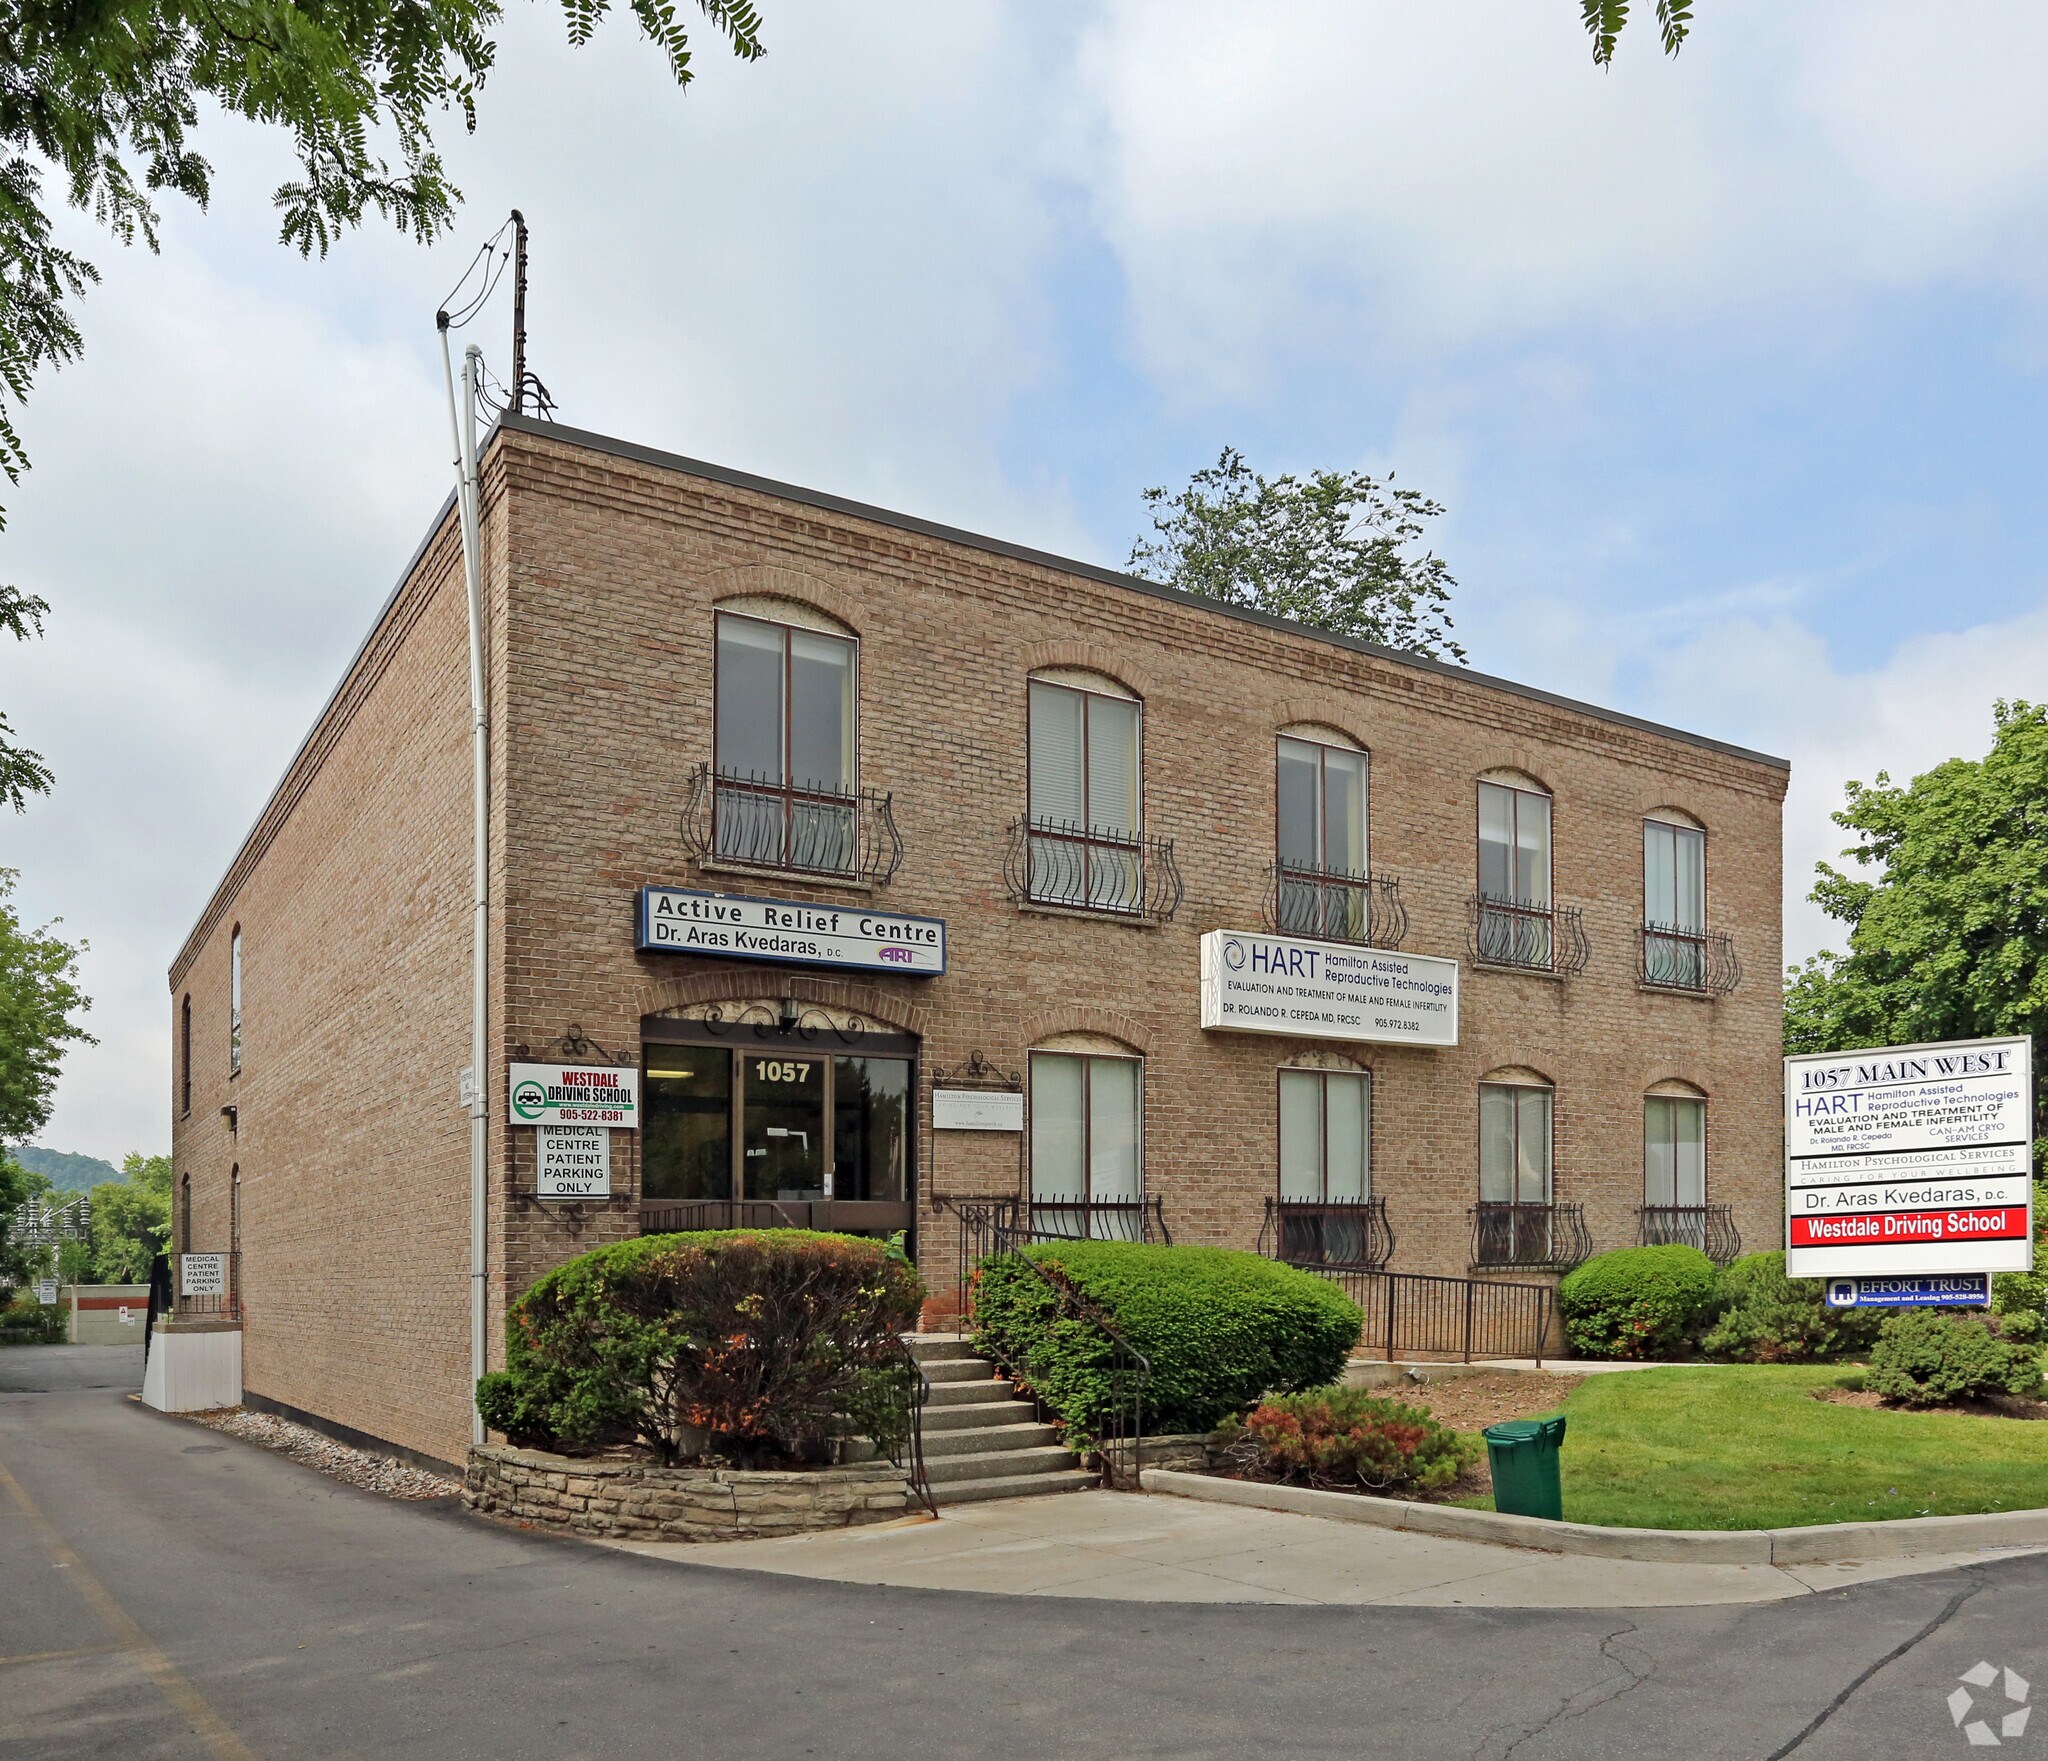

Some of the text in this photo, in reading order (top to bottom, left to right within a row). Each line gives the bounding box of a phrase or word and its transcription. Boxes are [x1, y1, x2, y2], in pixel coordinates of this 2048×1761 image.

[657, 896, 937, 942] Active Relief Centre
[656, 923, 844, 958] Dr. Aras Kvedaras, D.C.
[1252, 943, 1320, 978] HART
[1325, 953, 1408, 975] Hamilton Assisted
[1325, 969, 1452, 996] Reproductive Technologies
[1228, 980, 1447, 1013] EVALUATION AND TREATMENT OF MALE AND FEMALE INFERTILITY
[1223, 1002, 1420, 1031] DR. ROLANDO R. CEPEDA MD, FRCSC 905.972.8382
[562, 1071, 619, 1088] WESTDALE
[756, 1060, 810, 1083] 1057
[1802, 1050, 2011, 1090] 1057 MAIN WEST
[548, 1086, 632, 1103] DRIVING SCHOOL
[1868, 1084, 1963, 1101] Hamilton Assisted
[1868, 1090, 2019, 1113] Reproductive Technologies
[560, 1108, 624, 1122] 905-522-8381
[1796, 1094, 1864, 1118] HART
[1809, 1103, 2004, 1127] EVALUATION AND TREATMENT OF
[544, 1126, 603, 1137] MEDICAL
[1814, 1112, 1999, 1135] MALE AND FEMALE INFERTILITY
[1929, 1122, 2006, 1137] CAN-AM CRYO
[546, 1140, 600, 1151] CENTRE
[1810, 1132, 1893, 1145] Dr. Rolando R. Cepeda
[1846, 1142, 1871, 1151] FRCSC
[1945, 1132, 1989, 1144] SERVICES
[546, 1154, 602, 1165] PATIENT
[1801, 1148, 2015, 1171] HAMILTON PSYCHOLOGICAL SERVICES
[544, 1168, 604, 1179] PARKING
[1801, 1164, 2016, 1185] CARING FOR YOUR WELLBEING
[556, 1182, 592, 1193] ONLY
[1806, 1187, 2008, 1209] Dr. Aras Kvedaras, D.C.
[1808, 1211, 2006, 1239] Westdale Driving School
[1860, 1278, 1984, 1293] EFFORT TRUST
[1902, 1294, 1914, 1302] and
[1915, 1294, 1941, 1302] Leasing
